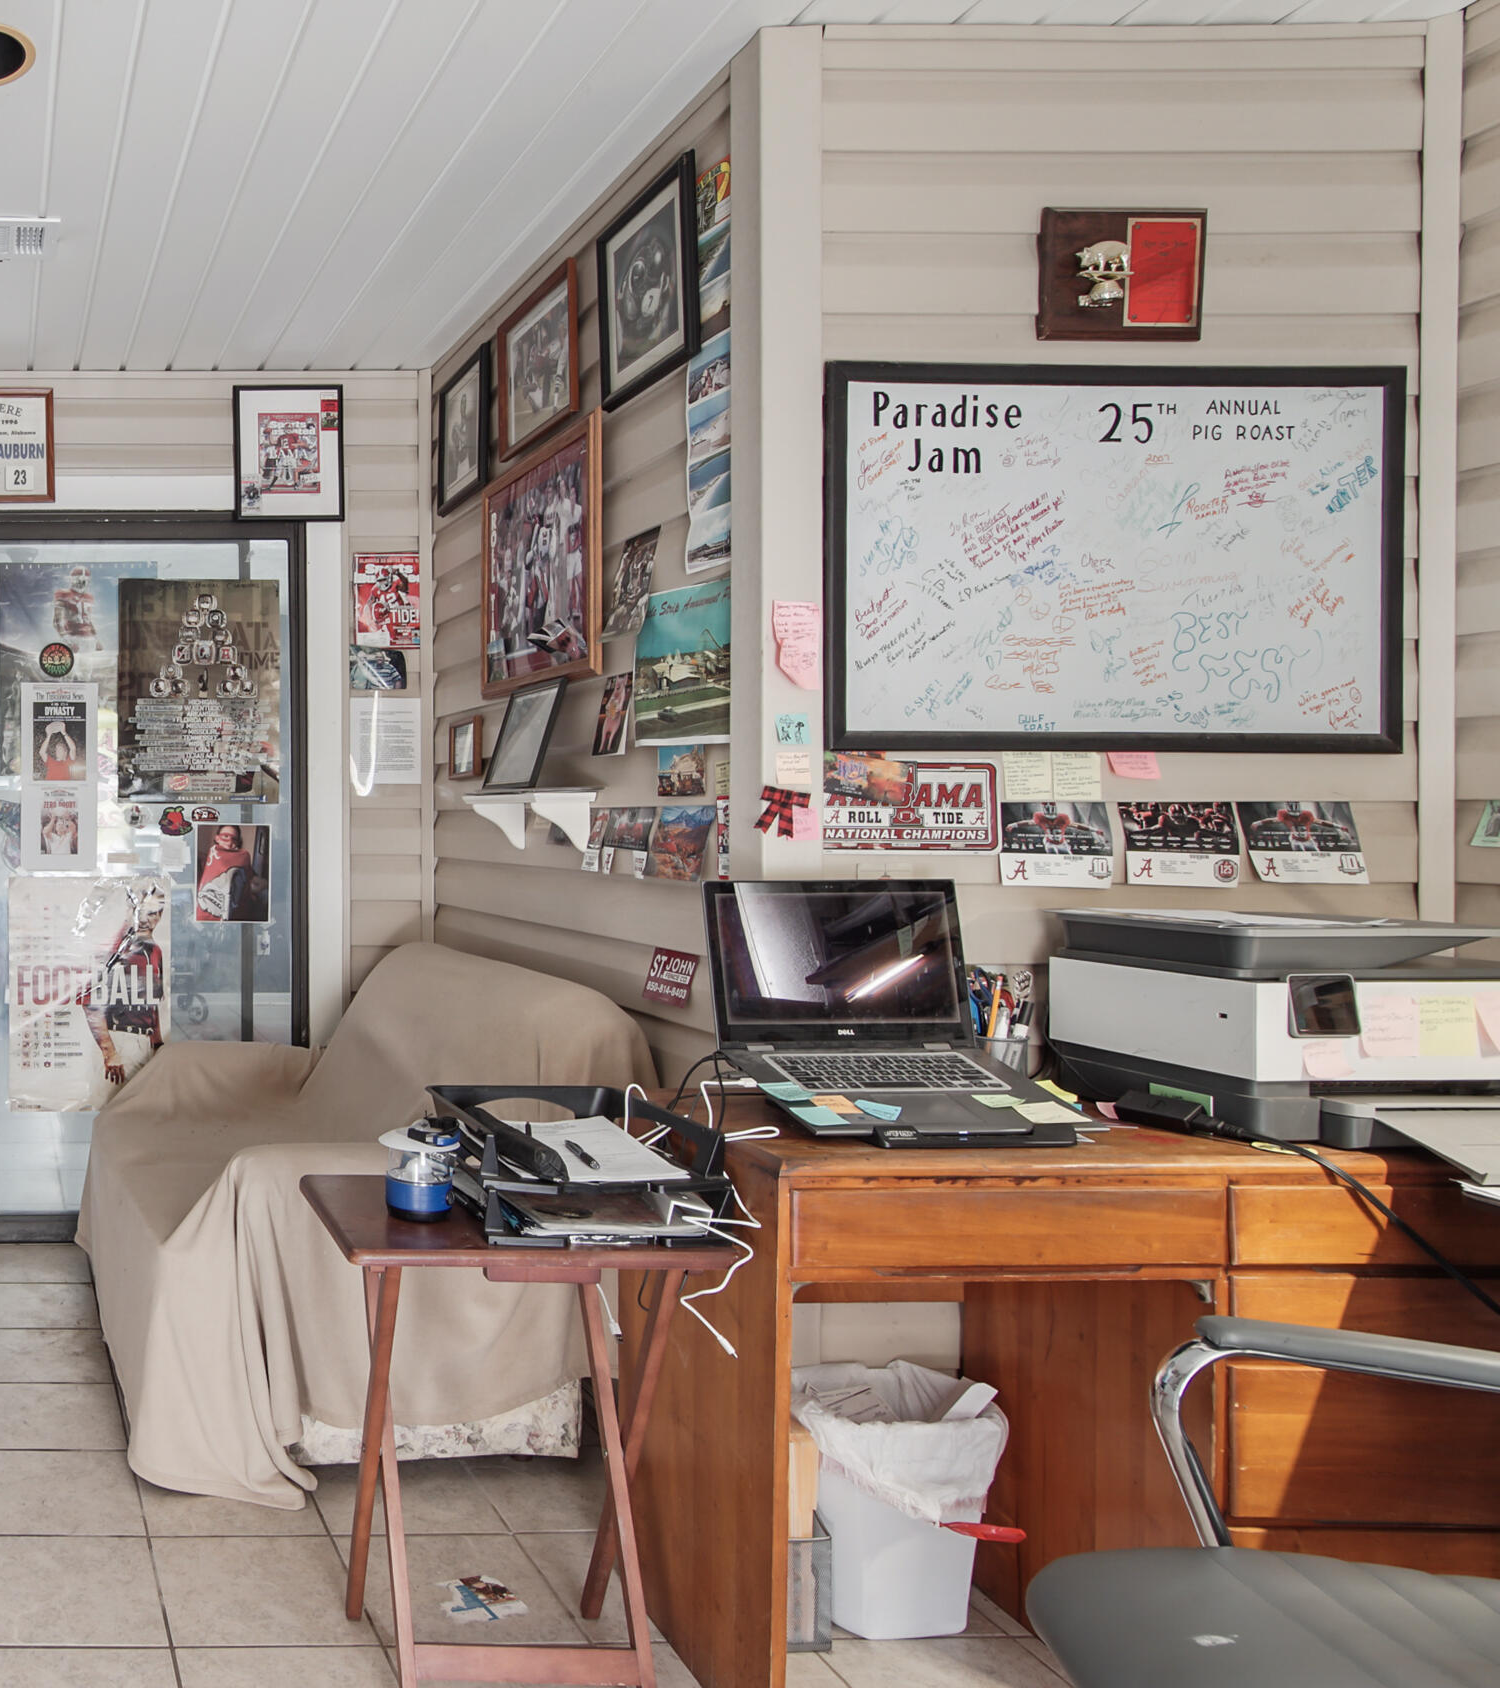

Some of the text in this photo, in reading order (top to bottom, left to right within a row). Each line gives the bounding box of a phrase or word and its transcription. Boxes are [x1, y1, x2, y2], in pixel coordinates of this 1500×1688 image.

[873, 391, 1022, 429] Paradise
[1206, 399, 1281, 416] ANNUAL
[1192, 424, 1296, 441] PIG ROAST
[907, 438, 981, 474] Jam
[13, 470, 27, 486] 23
[44, 706, 75, 716] DYNASTY
[1018, 713, 1045, 724] GULF
[1023, 722, 1056, 732] COAST
[848, 811, 882, 824] ROLL
[933, 811, 964, 824] TIDE
[825, 829, 986, 840] NATIONAL CHAMPIONS
[666, 957, 696, 976] JOHN
[17, 965, 161, 1006] FOOTBALL
